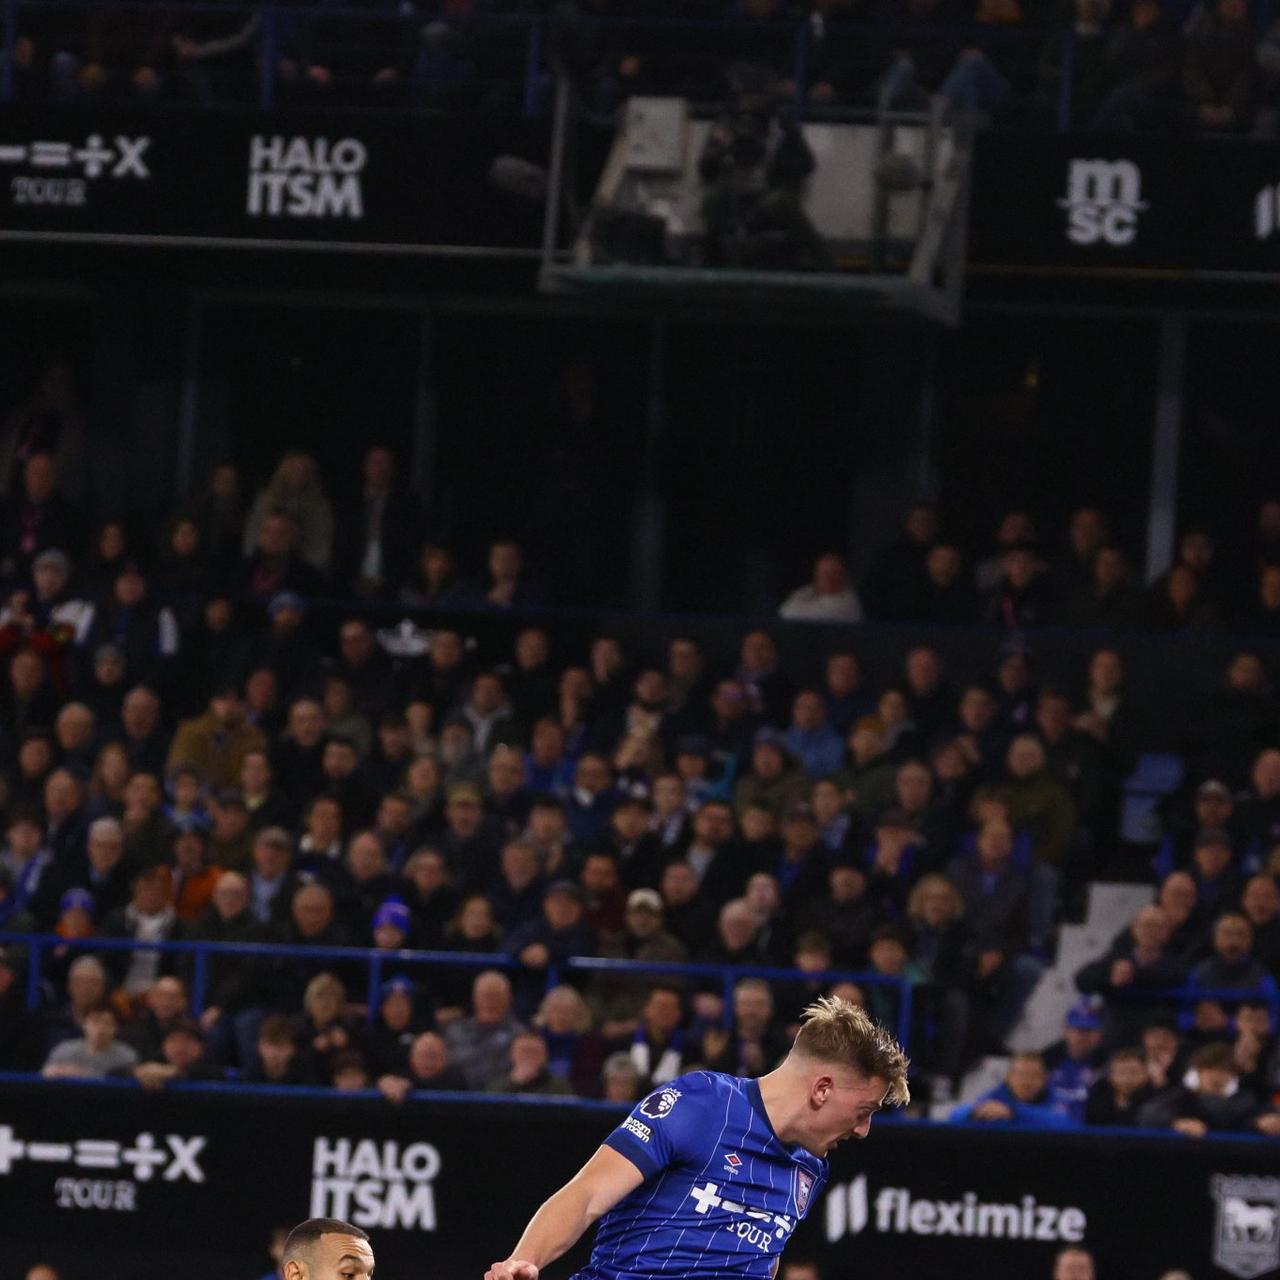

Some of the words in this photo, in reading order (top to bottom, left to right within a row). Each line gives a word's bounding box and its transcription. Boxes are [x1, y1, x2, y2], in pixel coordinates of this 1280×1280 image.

[251, 134, 367, 172] HALO
[248, 172, 363, 218] ITSM
[312, 1136, 441, 1181] HALO
[54, 1177, 138, 1212] TOUR
[309, 1178, 438, 1231] ITSM
[875, 1185, 1087, 1242] fleximize
